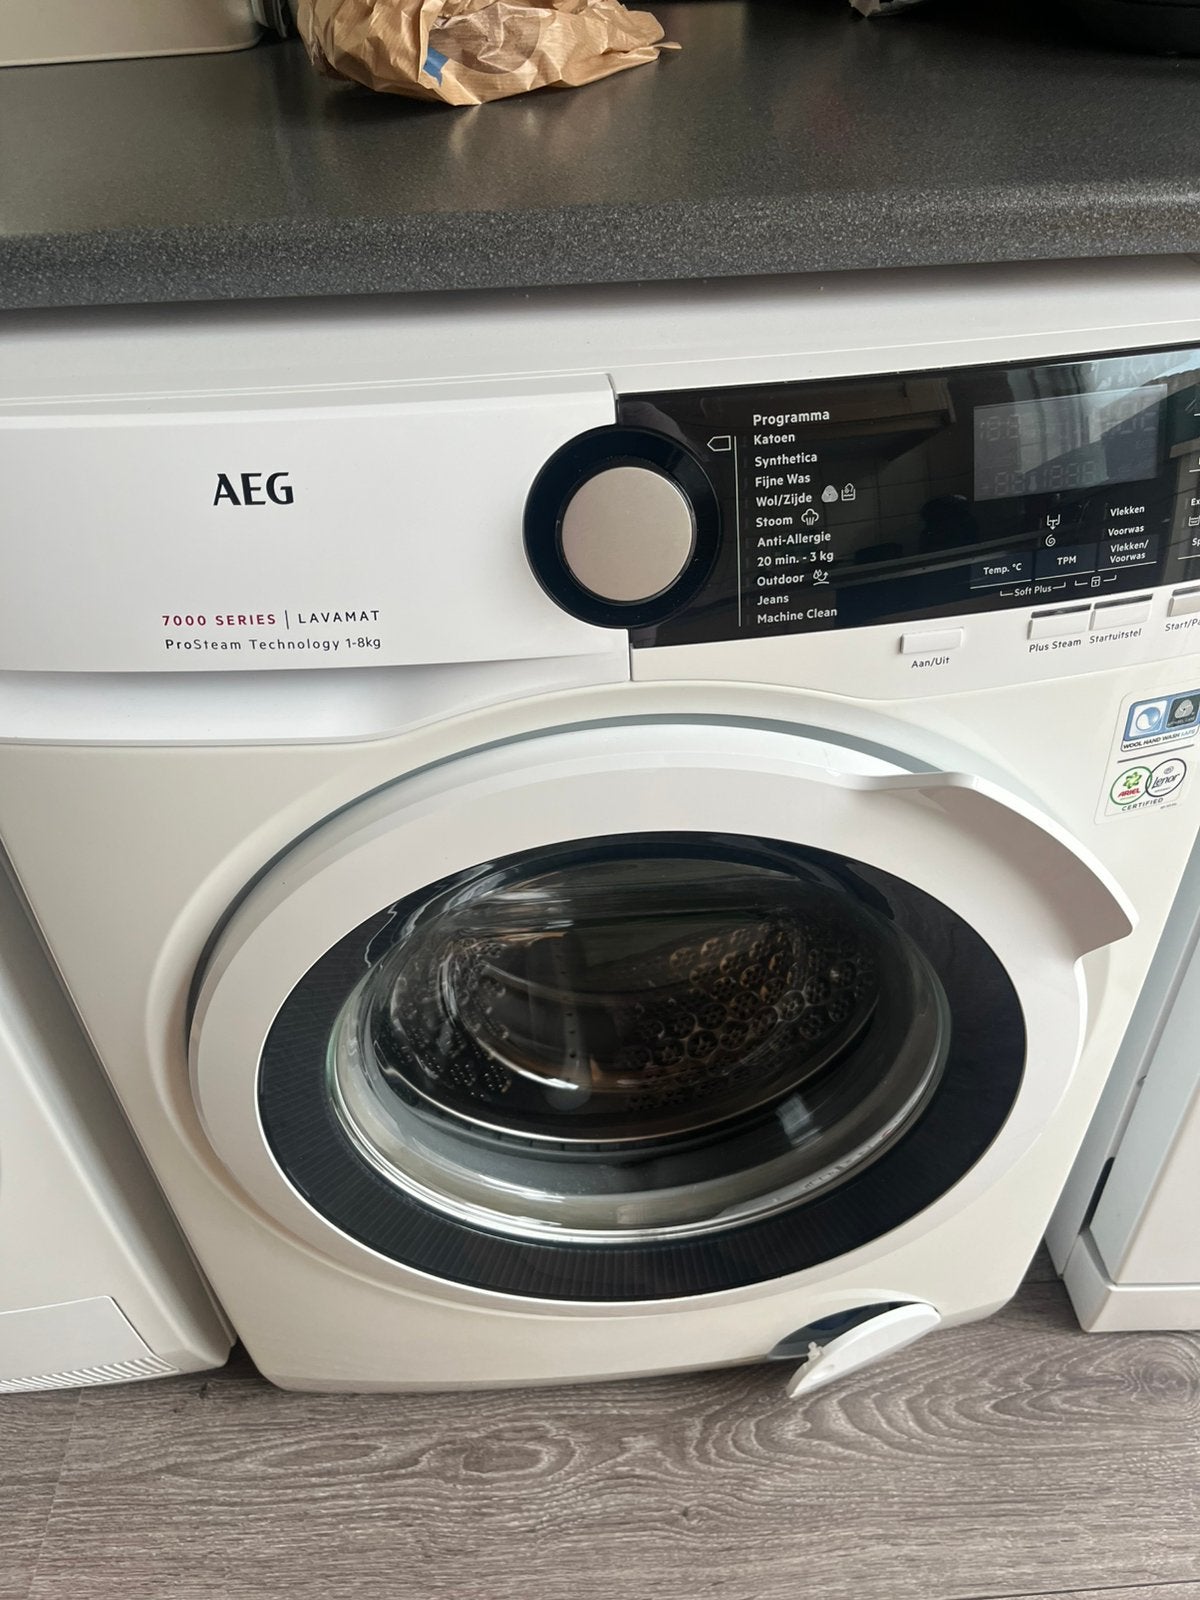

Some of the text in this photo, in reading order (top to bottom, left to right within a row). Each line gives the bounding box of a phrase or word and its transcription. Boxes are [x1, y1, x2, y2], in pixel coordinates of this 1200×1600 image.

[753, 411, 830, 426] Programma
[753, 433, 796, 445] Katoen
[754, 453, 818, 468] Synthetica
[755, 473, 811, 488] Fijne Was
[213, 472, 295, 506] AEG
[756, 494, 813, 508] Wol/Zijde
[1110, 505, 1145, 517] Vlekken
[756, 517, 793, 528] Stoom
[1108, 525, 1144, 537] Voorwas
[757, 532, 831, 547] Anti-Allergie
[1110, 539, 1149, 553] Vlekken/
[757, 557, 772, 567] 20
[775, 554, 799, 566] min.
[810, 552, 817, 563] 3
[820, 551, 834, 563] kg
[1056, 555, 1077, 566] TPM
[1109, 551, 1146, 564] Voorwas
[983, 565, 1010, 576] Temp.
[757, 574, 804, 587] Outdoor
[1014, 584, 1052, 597] Soft Plus
[757, 595, 789, 606] Jeans
[162, 613, 276, 626] 7000 SERIES
[298, 610, 379, 624] LAVAMAT
[757, 608, 838, 624] Machine Clean
[1089, 628, 1142, 644] Startuitstel
[165, 637, 381, 651] ProSteam Technology 1-8kg
[1029, 638, 1082, 653] Plus Steam
[911, 655, 950, 669] Aan/Uit
[1123, 742, 1142, 750] WOOL
[1143, 736, 1162, 746] HAND
[1162, 733, 1180, 742] WASH
[1118, 788, 1141, 798] ARIEL
[1122, 798, 1164, 812] CERTIFIED
